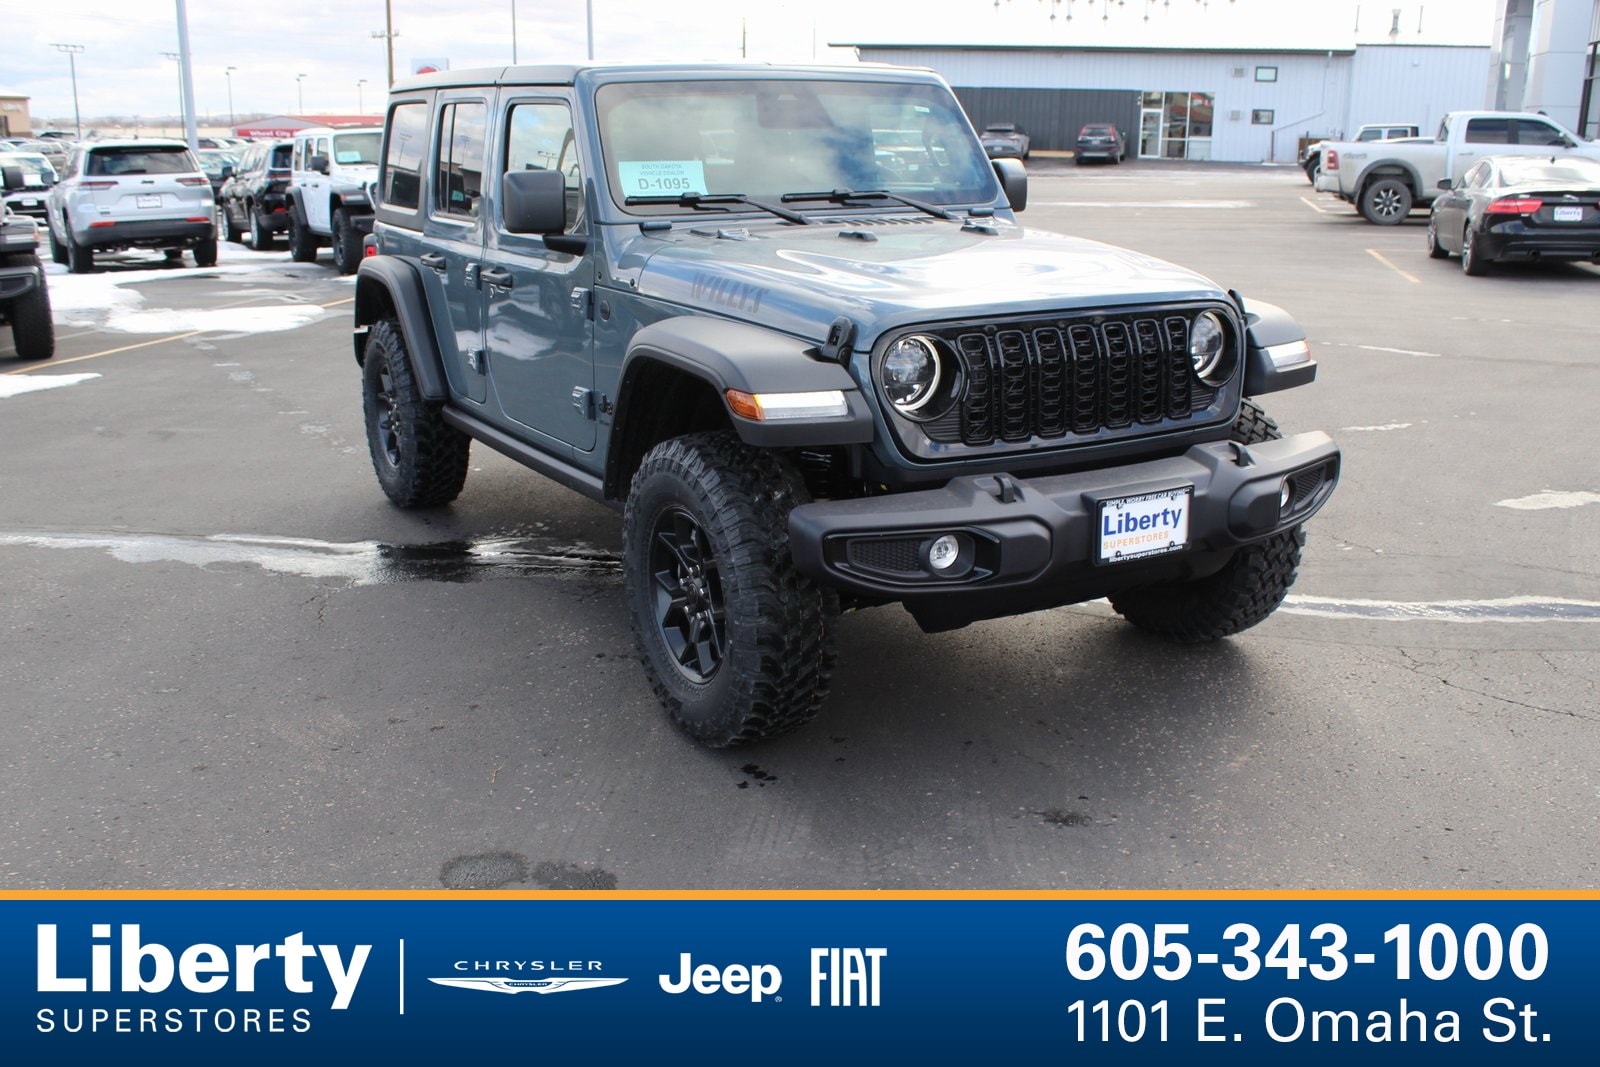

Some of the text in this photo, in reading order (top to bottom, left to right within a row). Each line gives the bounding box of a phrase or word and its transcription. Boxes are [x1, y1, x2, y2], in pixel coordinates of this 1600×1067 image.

[637, 177, 691, 190] D-1095
[691, 271, 770, 313] WILLYS
[1103, 508, 1182, 536] Liberty
[1103, 531, 1169, 550] SUPERSTORES
[1108, 545, 1183, 563] libertysuperstores.com
